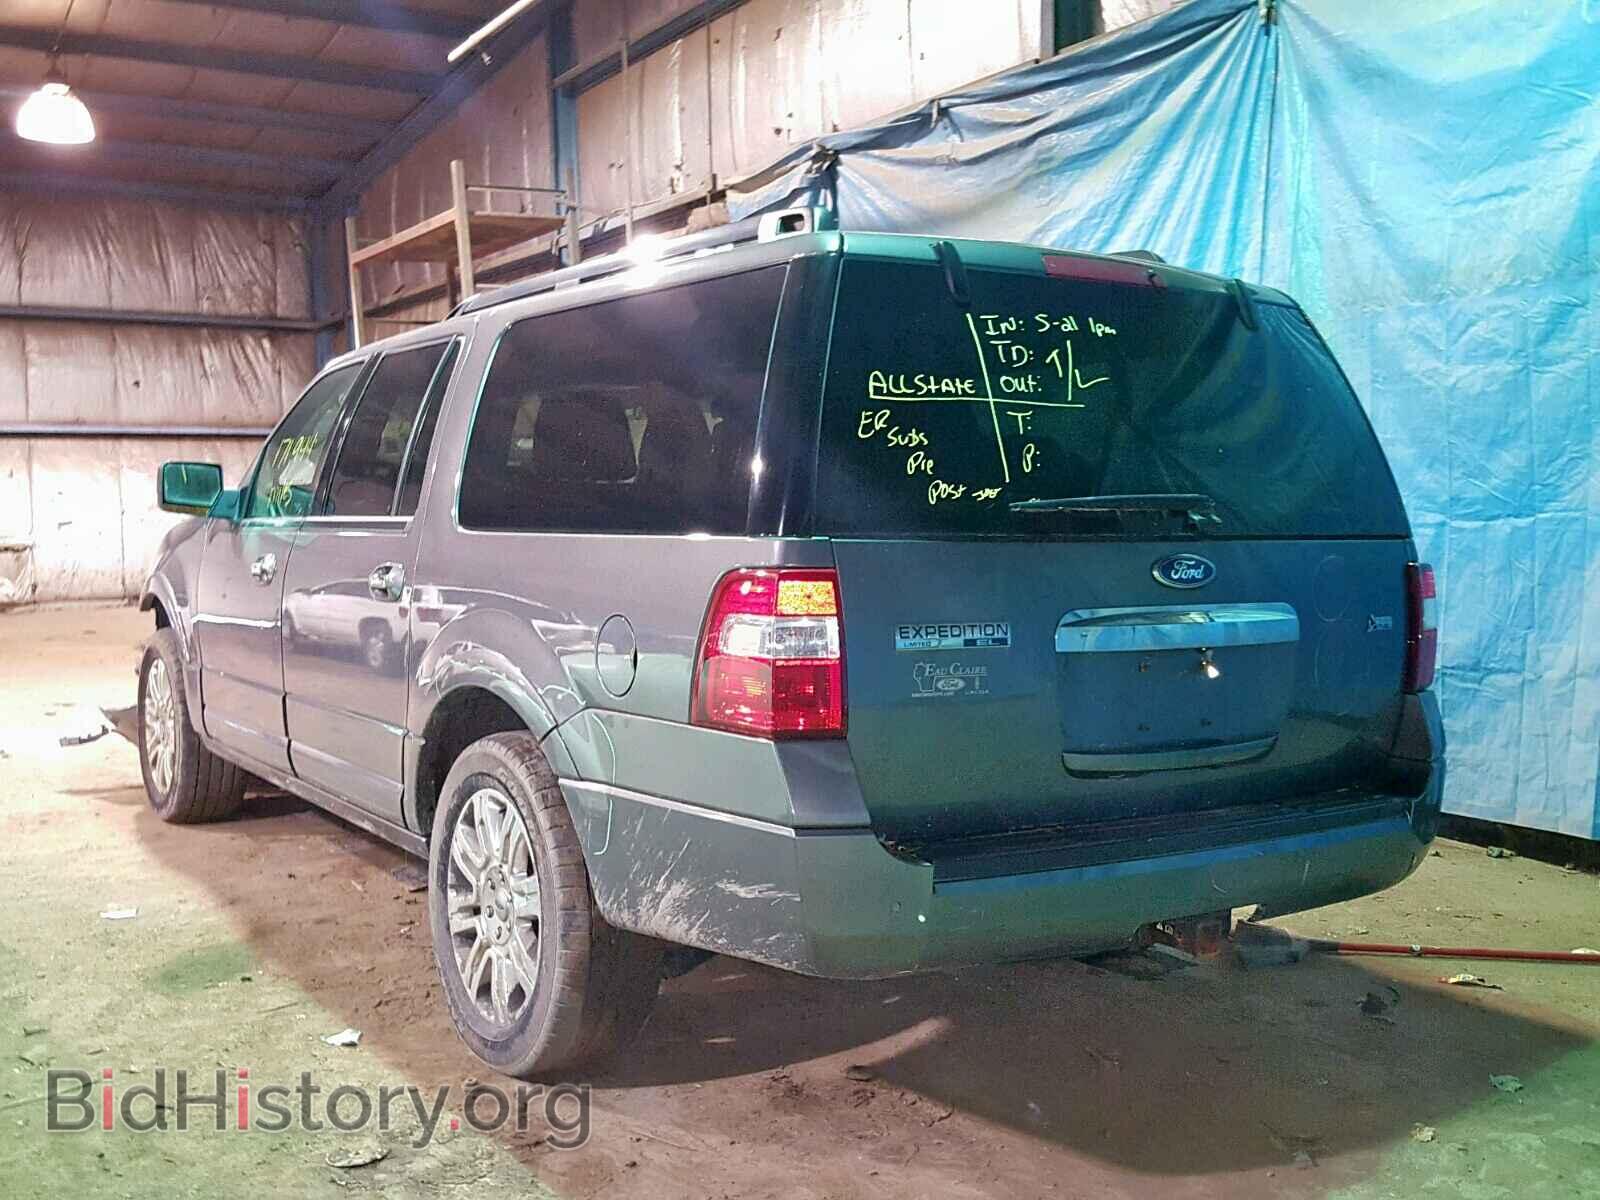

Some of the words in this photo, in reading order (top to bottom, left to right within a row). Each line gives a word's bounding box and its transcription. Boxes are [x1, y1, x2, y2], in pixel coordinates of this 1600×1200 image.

[858, 409, 891, 439] ER
[1171, 560, 1205, 579] Ford
[899, 623, 1009, 639] EXPEDITION
